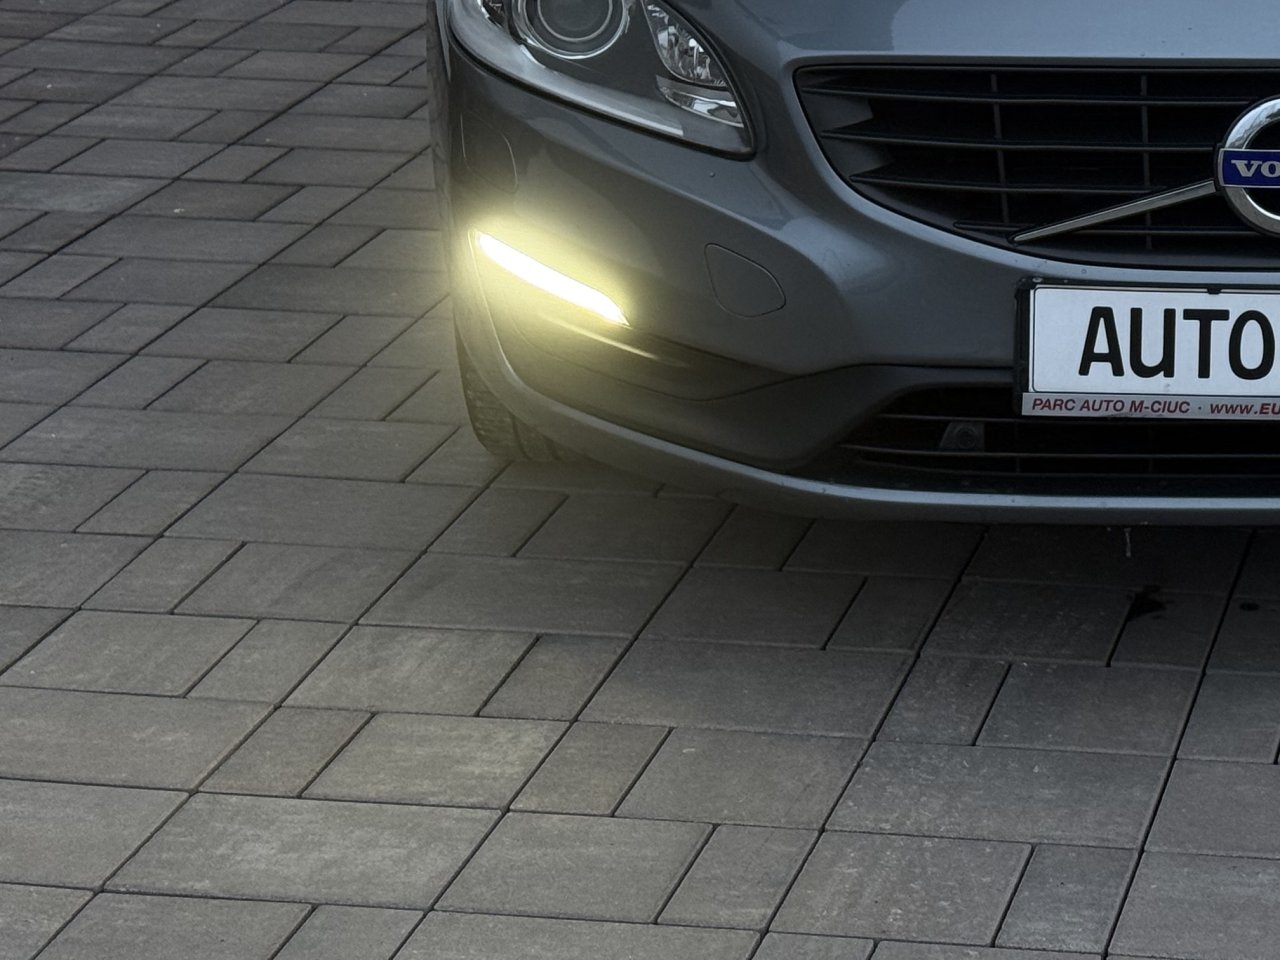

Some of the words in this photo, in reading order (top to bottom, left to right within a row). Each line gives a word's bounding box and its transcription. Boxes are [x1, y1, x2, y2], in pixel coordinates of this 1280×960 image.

[1032, 398, 1076, 411] PARC
[1079, 398, 1125, 412] AUTO
[1129, 400, 1191, 414] M-CIUC
